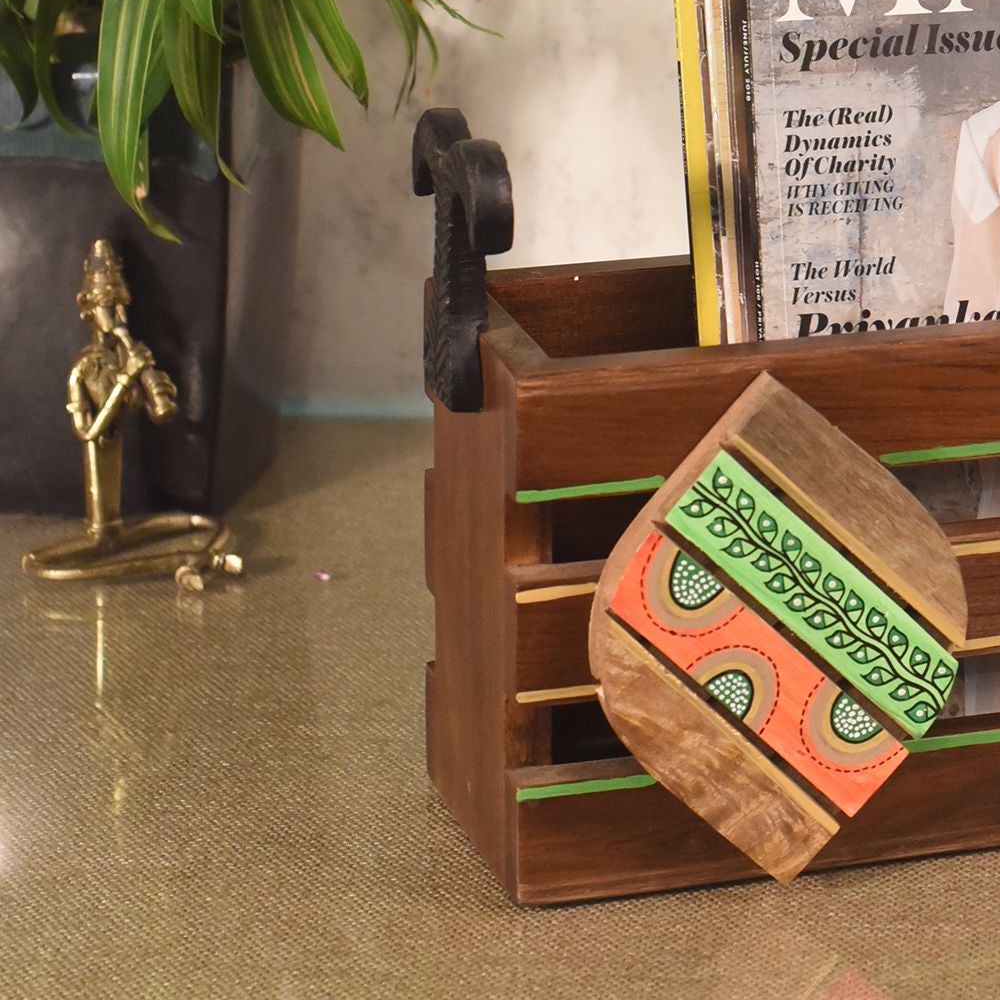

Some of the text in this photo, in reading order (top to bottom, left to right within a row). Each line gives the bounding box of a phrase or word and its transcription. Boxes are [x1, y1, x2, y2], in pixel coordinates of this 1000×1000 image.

[742, 19, 750, 75] JUNE/JULY
[779, 23, 919, 72] Special
[783, 104, 893, 129] The (Real)
[784, 130, 893, 157] Dynamics
[784, 153, 897, 181] Of Charity
[787, 179, 895, 200] WHY GIVING
[787, 197, 904, 218] IS RECEIVING
[790, 256, 897, 282] The World
[791, 286, 857, 306] Versus
